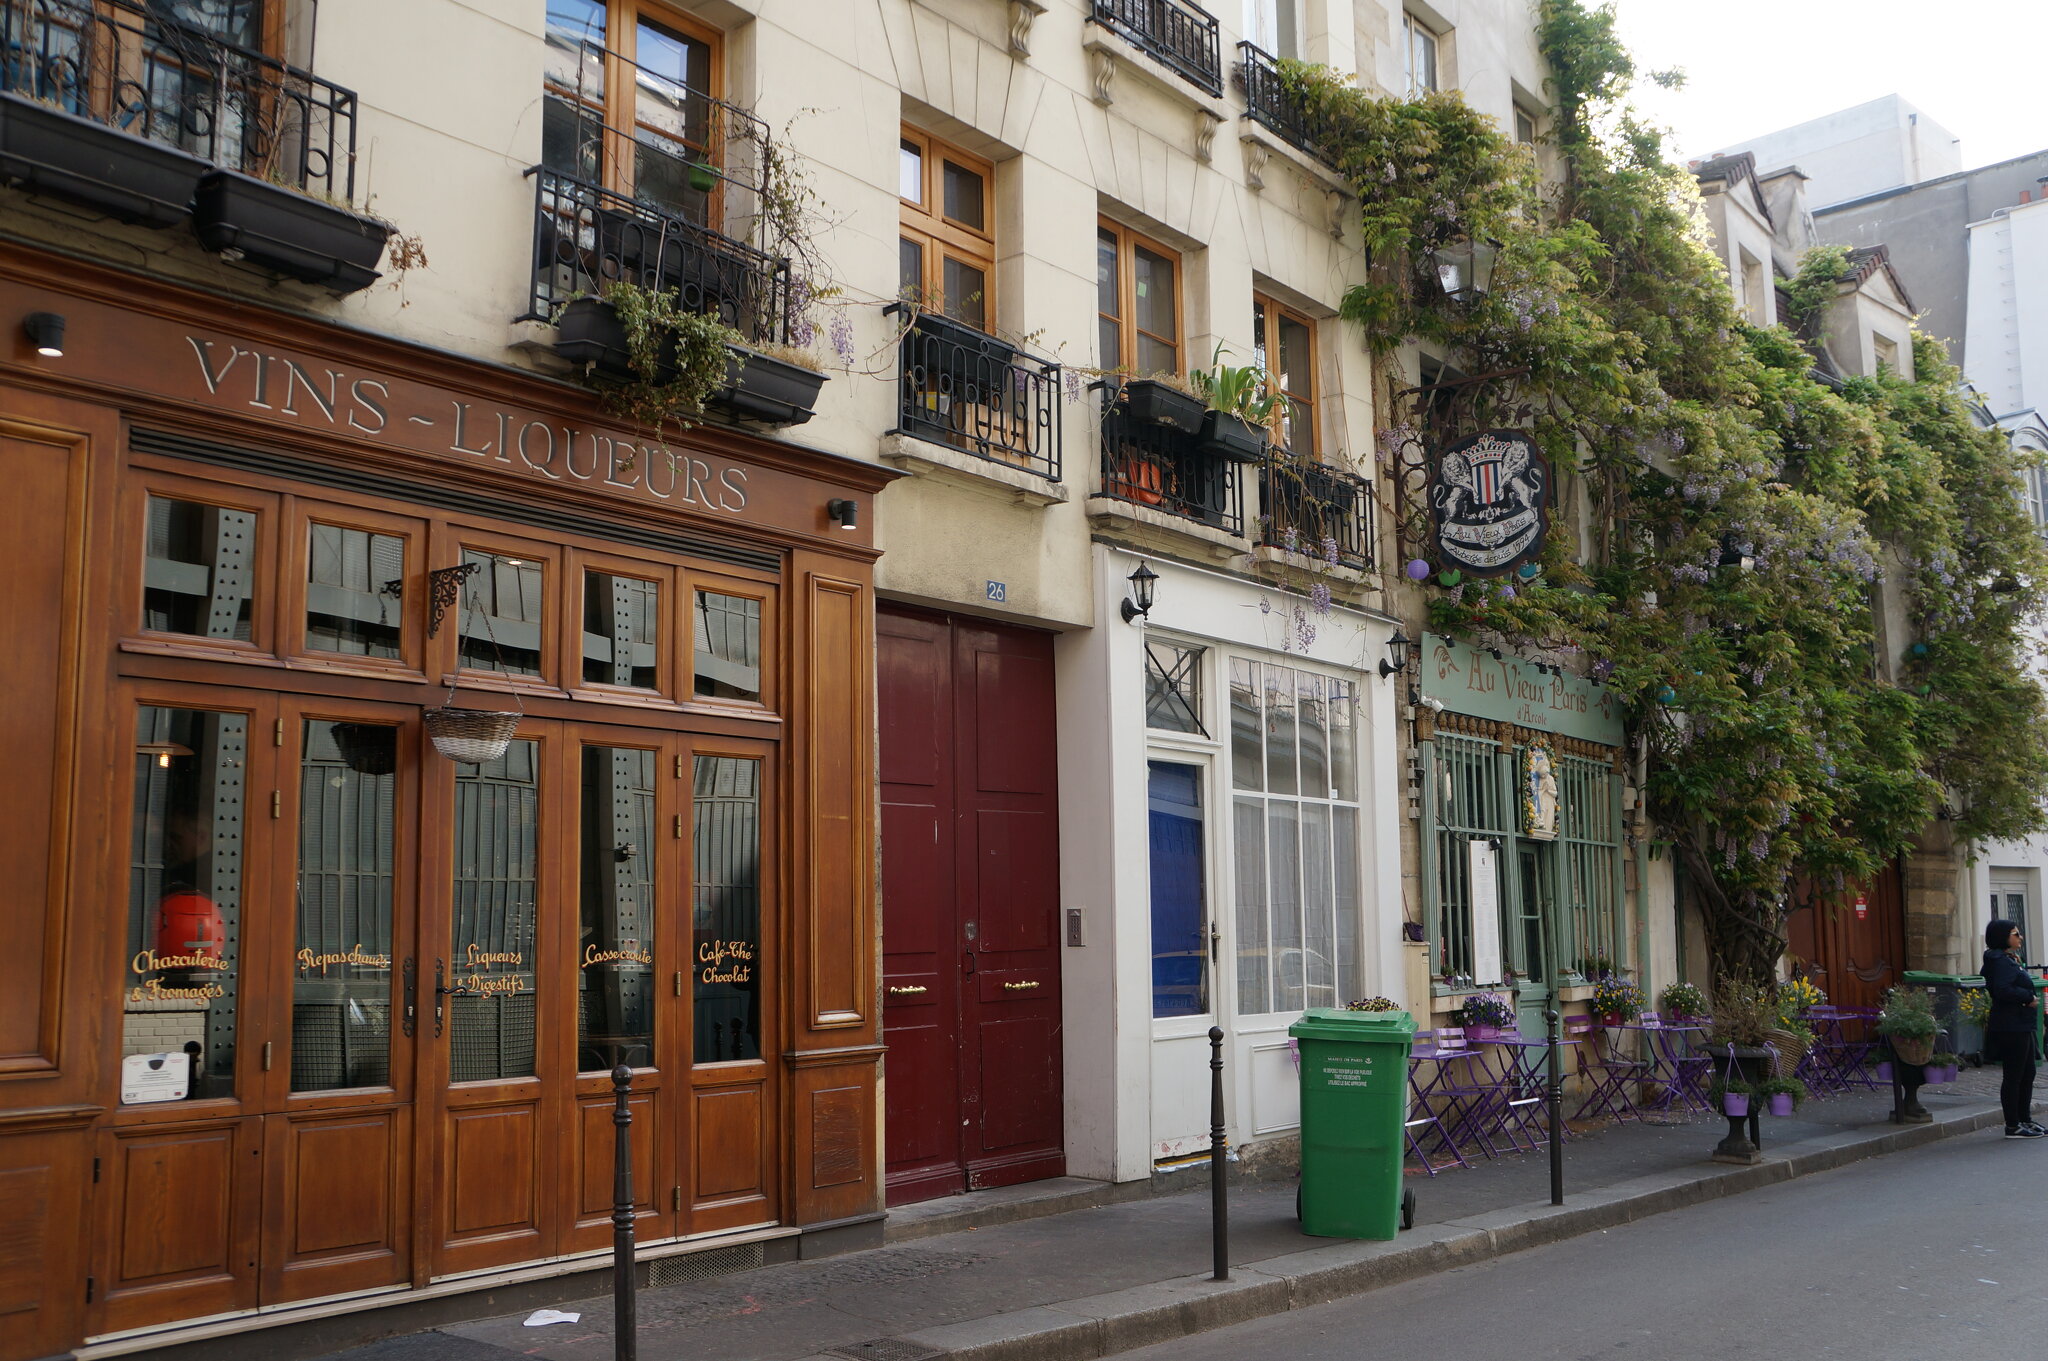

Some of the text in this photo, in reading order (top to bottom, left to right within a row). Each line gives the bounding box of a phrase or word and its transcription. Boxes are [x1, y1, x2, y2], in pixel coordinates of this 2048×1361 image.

[185, 337, 389, 435] VINS
[449, 402, 749, 513] LIQUEURS
[1452, 517, 1527, 541] Au Vieux Paris
[1449, 534, 1530, 565] Auberge depuis 1594
[989, 583, 1004, 600] 26
[1467, 653, 1588, 714] Au Vieux Paris
[1517, 703, 1548, 726] d'Arcole
[131, 947, 230, 975] Charcuterie
[464, 943, 522, 970] Liqueurs
[467, 973, 524, 1000] Digestifs
[702, 964, 751, 984] Chocolat
[131, 976, 225, 1005] & Fromages
